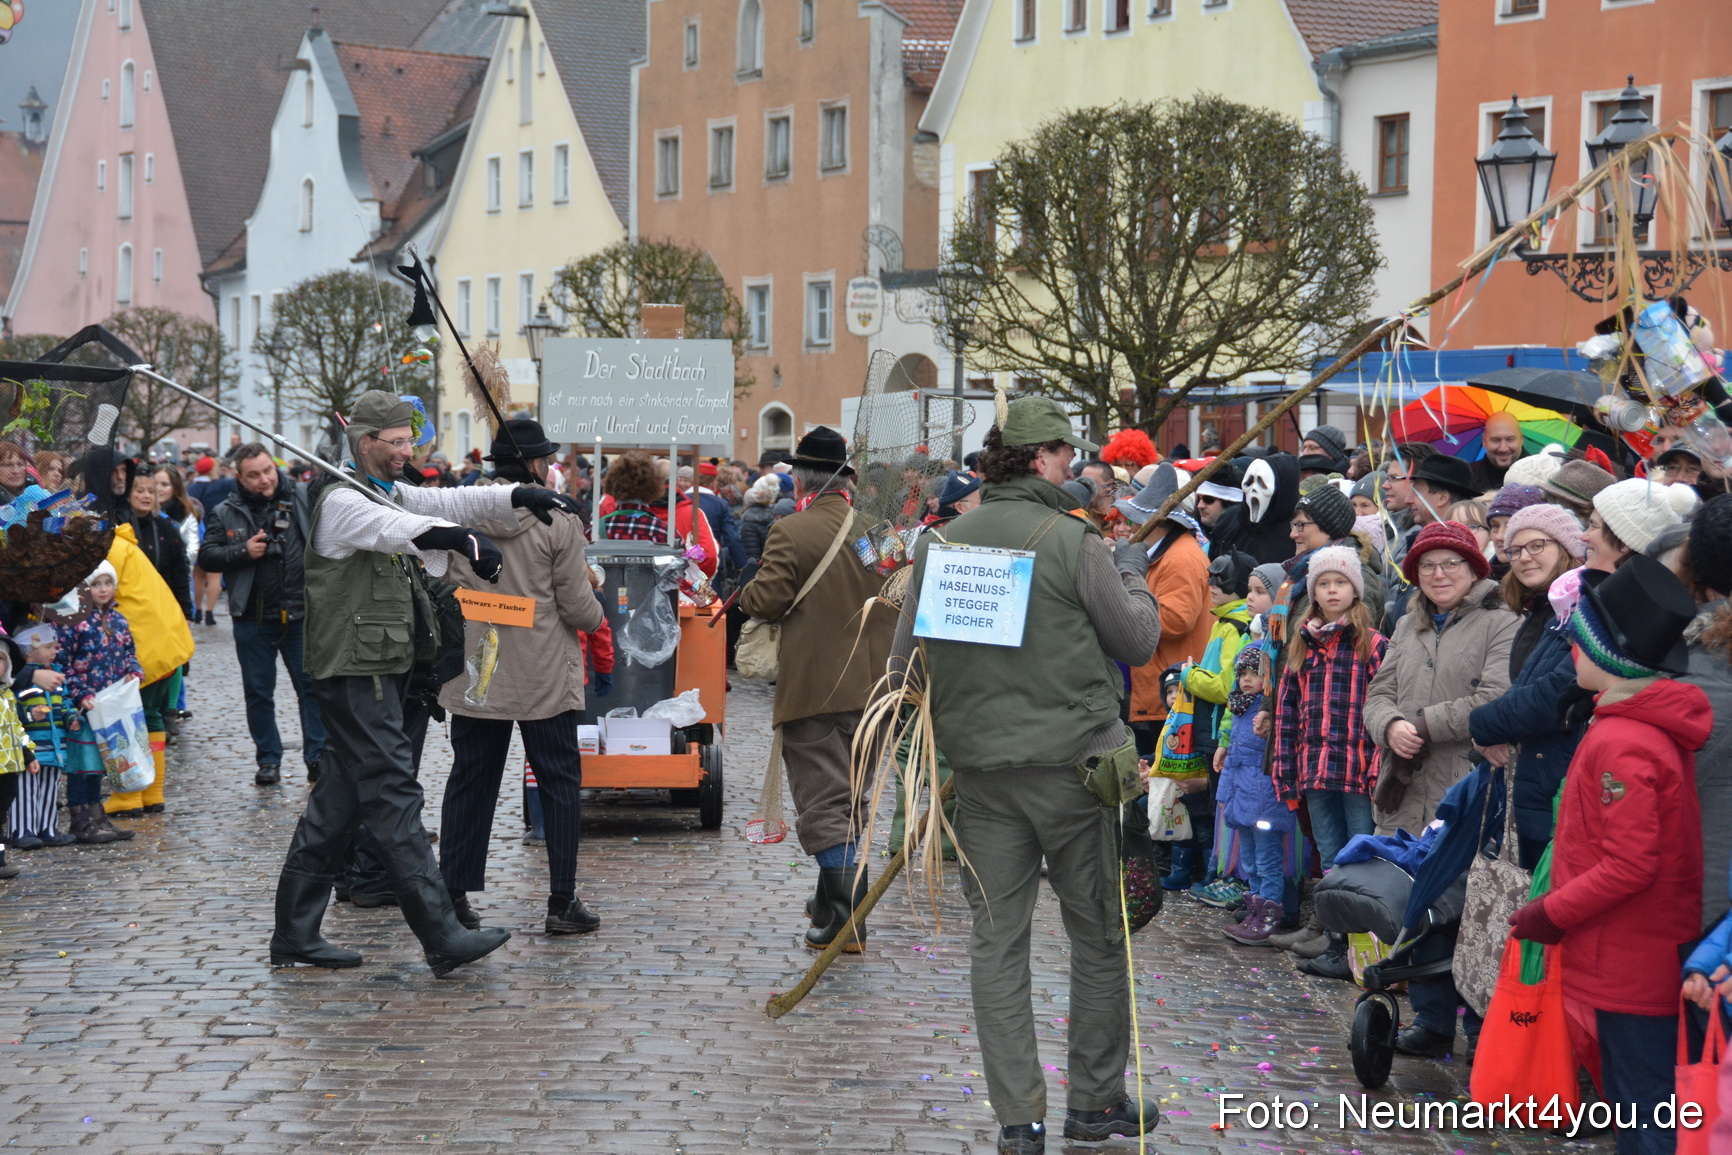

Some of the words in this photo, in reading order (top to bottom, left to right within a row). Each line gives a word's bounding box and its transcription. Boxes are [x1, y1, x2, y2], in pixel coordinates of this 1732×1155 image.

[583, 350, 617, 379] Der
[626, 353, 707, 381] Stadtbach
[549, 391, 563, 406] ist
[568, 396, 587, 406] nur
[590, 392, 613, 406] noch
[619, 394, 635, 407] ein
[639, 391, 693, 407] stinkender
[695, 388, 730, 413] Tümpel
[548, 418, 568, 434] voll
[577, 416, 598, 433] mit
[606, 415, 641, 434] Unrat
[647, 418, 671, 434] und
[677, 415, 732, 440] Gerümpel
[943, 564, 1011, 580] STADTBACH
[939, 580, 1010, 596] HASELNUSS-
[461, 598, 491, 608] Schwarz
[498, 603, 527, 612] Fischer
[945, 597, 999, 612] STEGGER
[945, 614, 994, 628] FISCHER
